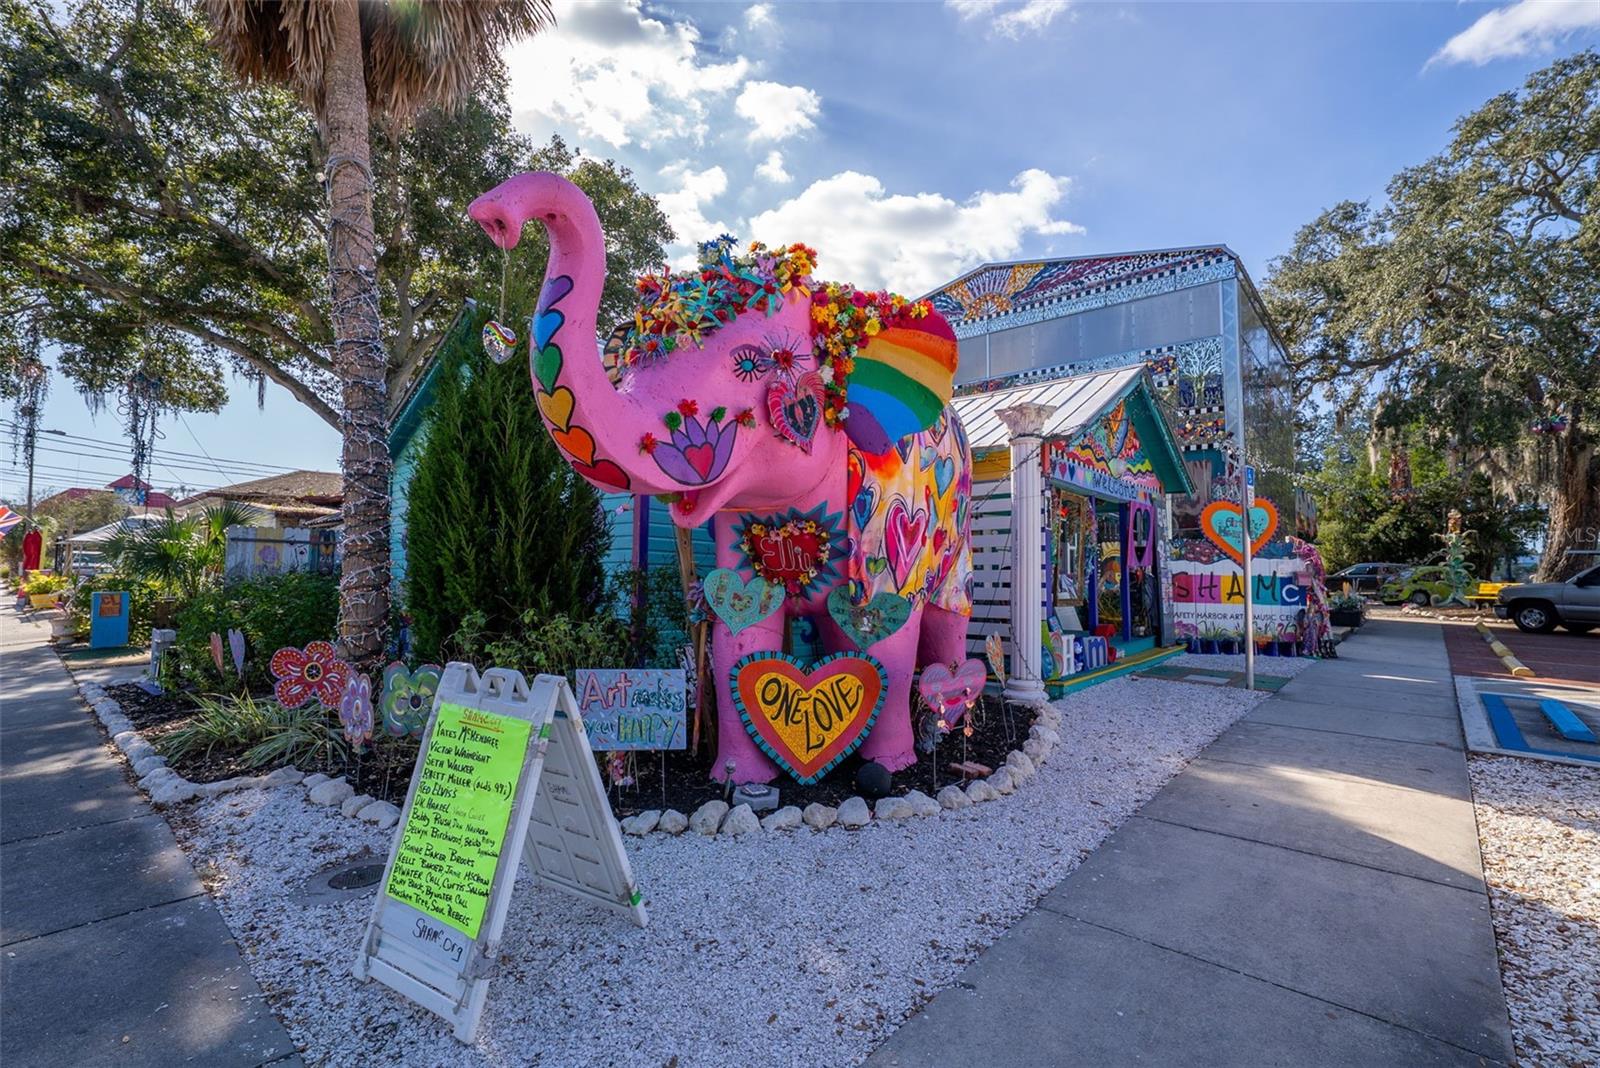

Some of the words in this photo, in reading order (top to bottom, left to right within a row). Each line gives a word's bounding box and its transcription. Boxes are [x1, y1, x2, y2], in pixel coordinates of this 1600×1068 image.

[1197, 611, 1229, 621] HARBOR
[1253, 612, 1277, 621] MUSIC
[581, 671, 632, 710] Art
[761, 677, 812, 727] ONE
[617, 712, 680, 751] HAPPY
[804, 676, 863, 753] LOVE
[447, 758, 475, 775] WALKER
[424, 842, 447, 862] BAKER
